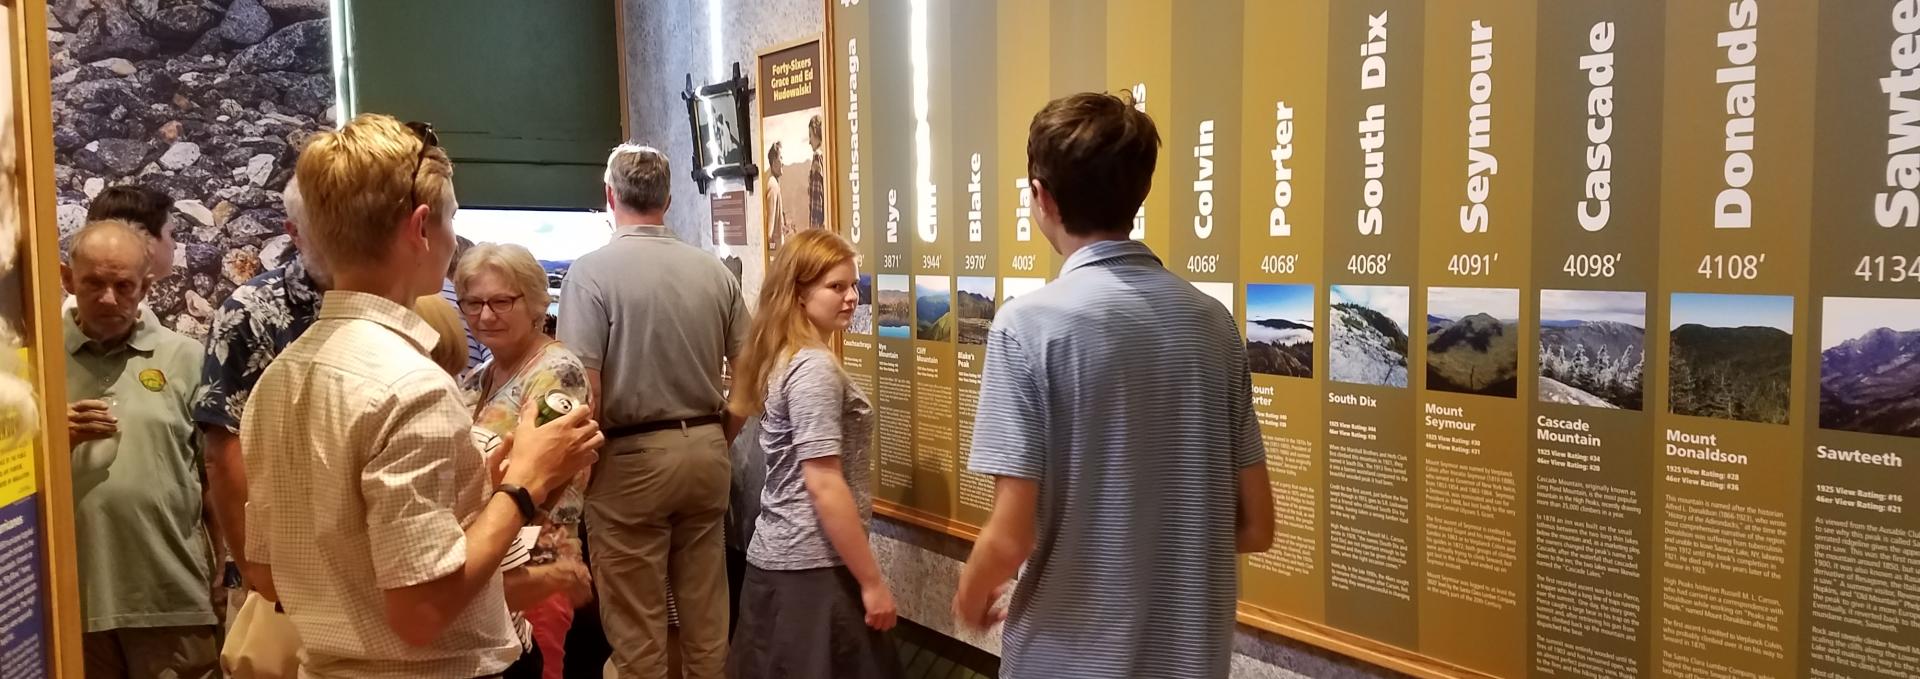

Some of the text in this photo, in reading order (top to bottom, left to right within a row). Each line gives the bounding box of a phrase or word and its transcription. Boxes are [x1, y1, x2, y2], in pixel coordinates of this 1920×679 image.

[772, 57, 812, 76] Forty-Sixers
[771, 67, 814, 89] Grace and Ed
[773, 81, 812, 102] Hudowalski
[1357, 10, 1387, 235] South Dix
[1460, 20, 1497, 233] Seymour
[1577, 21, 1614, 232] Cascade
[848, 38, 861, 243] Couchsachraga
[1269, 101, 1293, 237] Porter
[1194, 120, 1214, 240] Colvin
[968, 152, 981, 242] Blake
[887, 188, 900, 243] Nye
[1016, 178, 1031, 241] Dial
[1252, 396, 1272, 406] orter
[1329, 393, 1376, 407] South Dix
[1425, 403, 1463, 417] Mount
[1425, 416, 1475, 431] Seymour
[1537, 414, 1589, 432] Cascade
[1537, 428, 1601, 447] Mountain
[1667, 429, 1717, 446] Mount
[1551, 459, 1565, 467] View
[1552, 450, 1566, 458] View
[1666, 443, 1748, 465] Donaldson
[1817, 446, 1902, 467] Sawteeth
[1667, 465, 1681, 473] 1925
[1683, 467, 1699, 475] View
[1666, 475, 1680, 483] 46er
[1682, 477, 1699, 485] View
[1817, 485, 1834, 493] 1925
[1835, 487, 1856, 496] View
[1857, 490, 1886, 502] Rating:
[1816, 495, 1833, 504] 46er
[1835, 498, 1855, 507] View
[1857, 501, 1885, 513] Rating:
